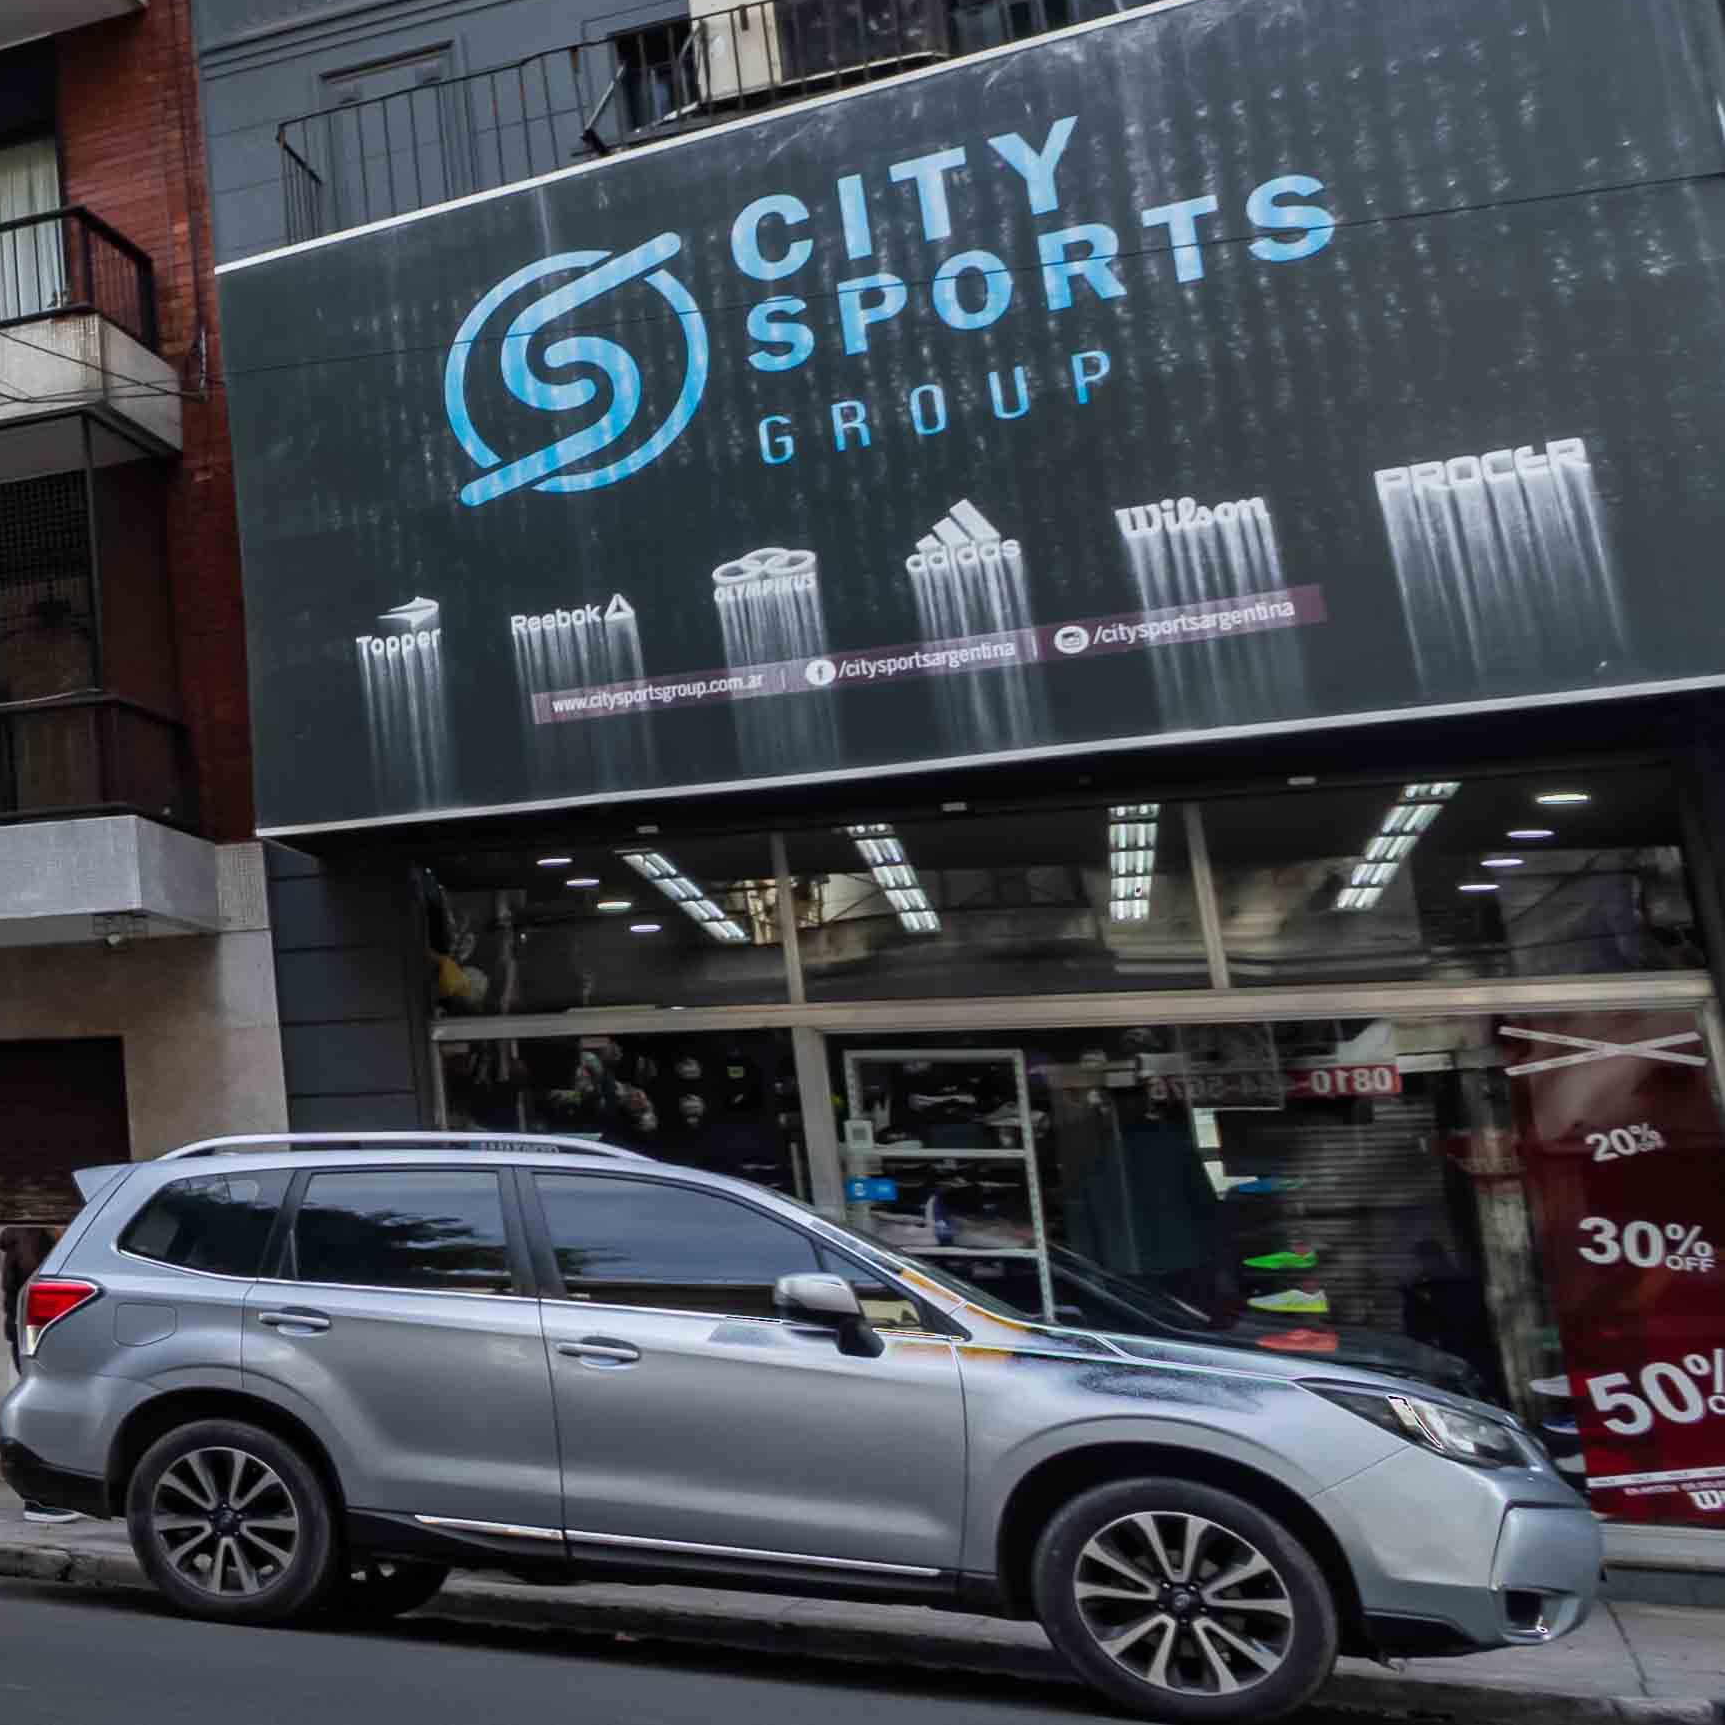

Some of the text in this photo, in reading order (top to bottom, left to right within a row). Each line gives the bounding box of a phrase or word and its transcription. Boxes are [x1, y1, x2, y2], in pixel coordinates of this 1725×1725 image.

[731, 116, 1078, 281] CITY
[747, 175, 1336, 371] SPORTS
[758, 350, 1110, 465] GROUP
[1374, 437, 1591, 490] PROCER
[1116, 497, 1270, 537] Wilson
[906, 539, 1021, 572] adidas
[714, 573, 817, 602] OLYMPIKUS
[511, 604, 601, 635] Reebok
[356, 628, 442, 657] Topper
[552, 673, 764, 714] www.citysportsgroup.com.ar
[1585, 1123, 1662, 1162] 20%
[1578, 1216, 1714, 1268] 30%
[1665, 1255, 1716, 1272] OFF
[1586, 1348, 1725, 1435] 50%
